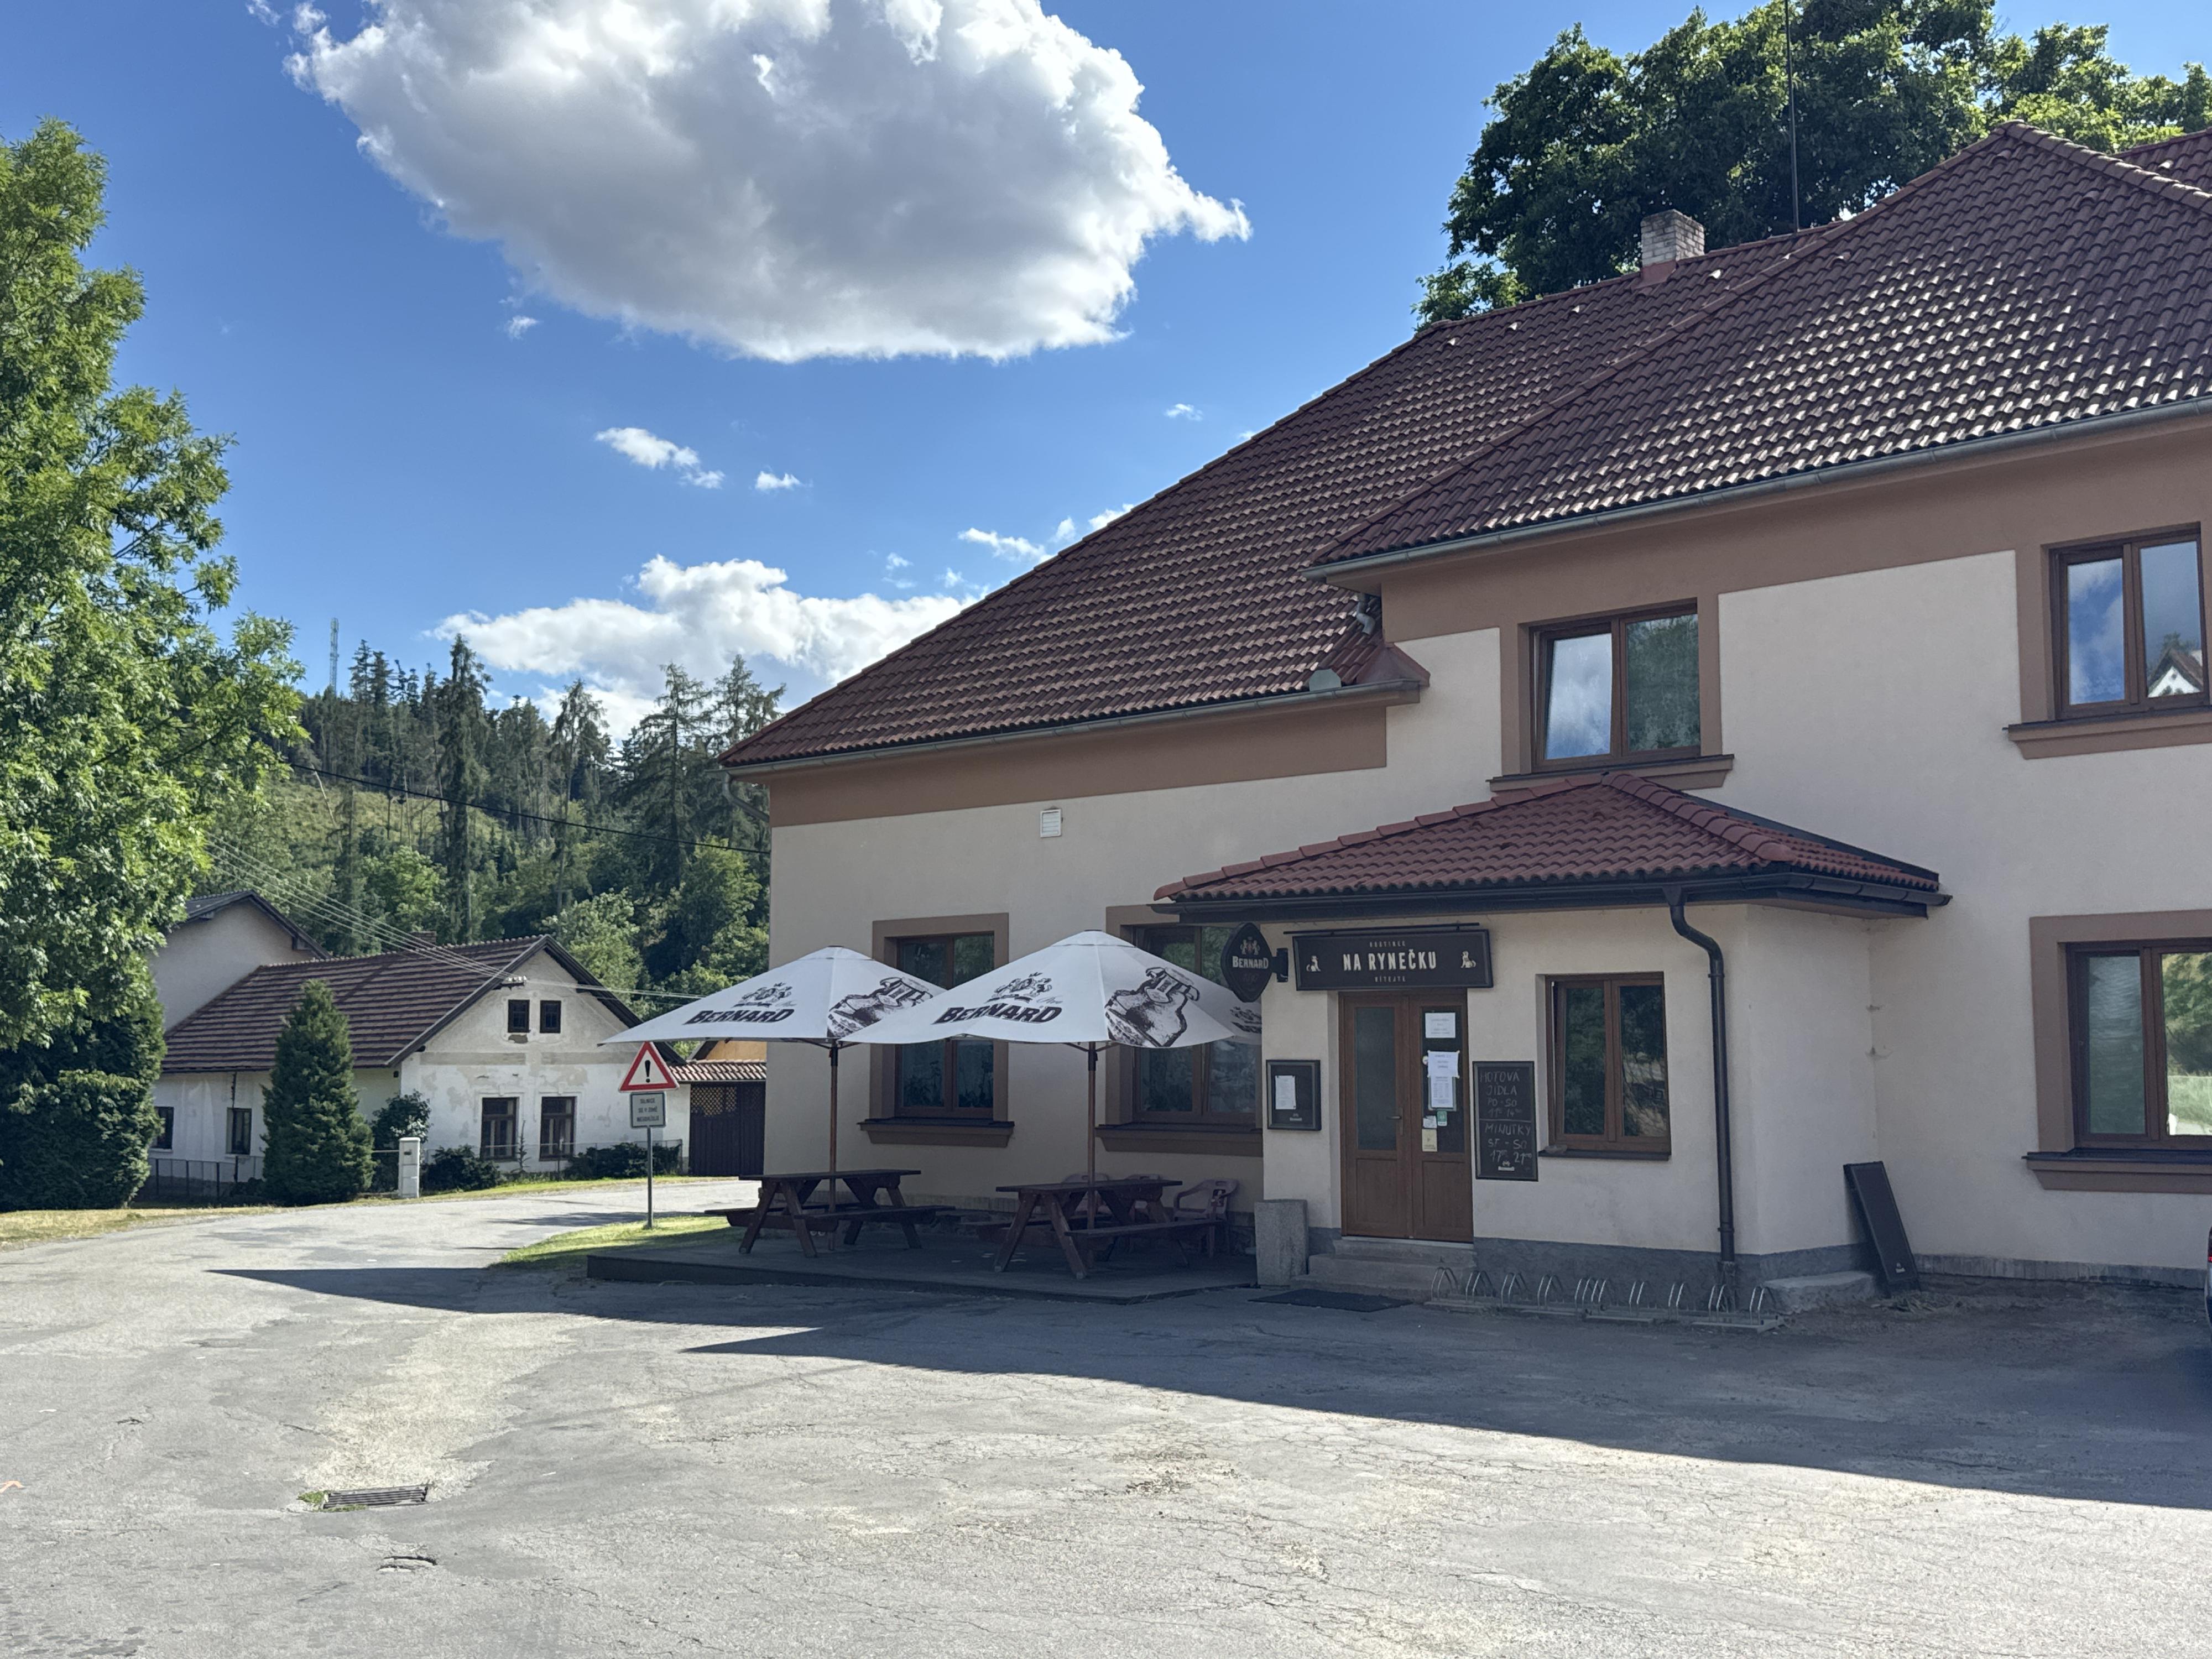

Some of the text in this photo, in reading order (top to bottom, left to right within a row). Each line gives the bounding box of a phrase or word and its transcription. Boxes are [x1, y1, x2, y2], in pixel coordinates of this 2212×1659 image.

[1232, 956, 1269, 969] BERNARD
[1343, 948, 1437, 971] NA RYNEČKU
[682, 1009, 795, 1025] BERNARD
[931, 1003, 1062, 1024] BERNARD
[1480, 1068, 1520, 1083] HOTOVÁ
[1486, 1082, 1517, 1096] JÍDLA
[1484, 1123, 1531, 1136] MINUTKY
